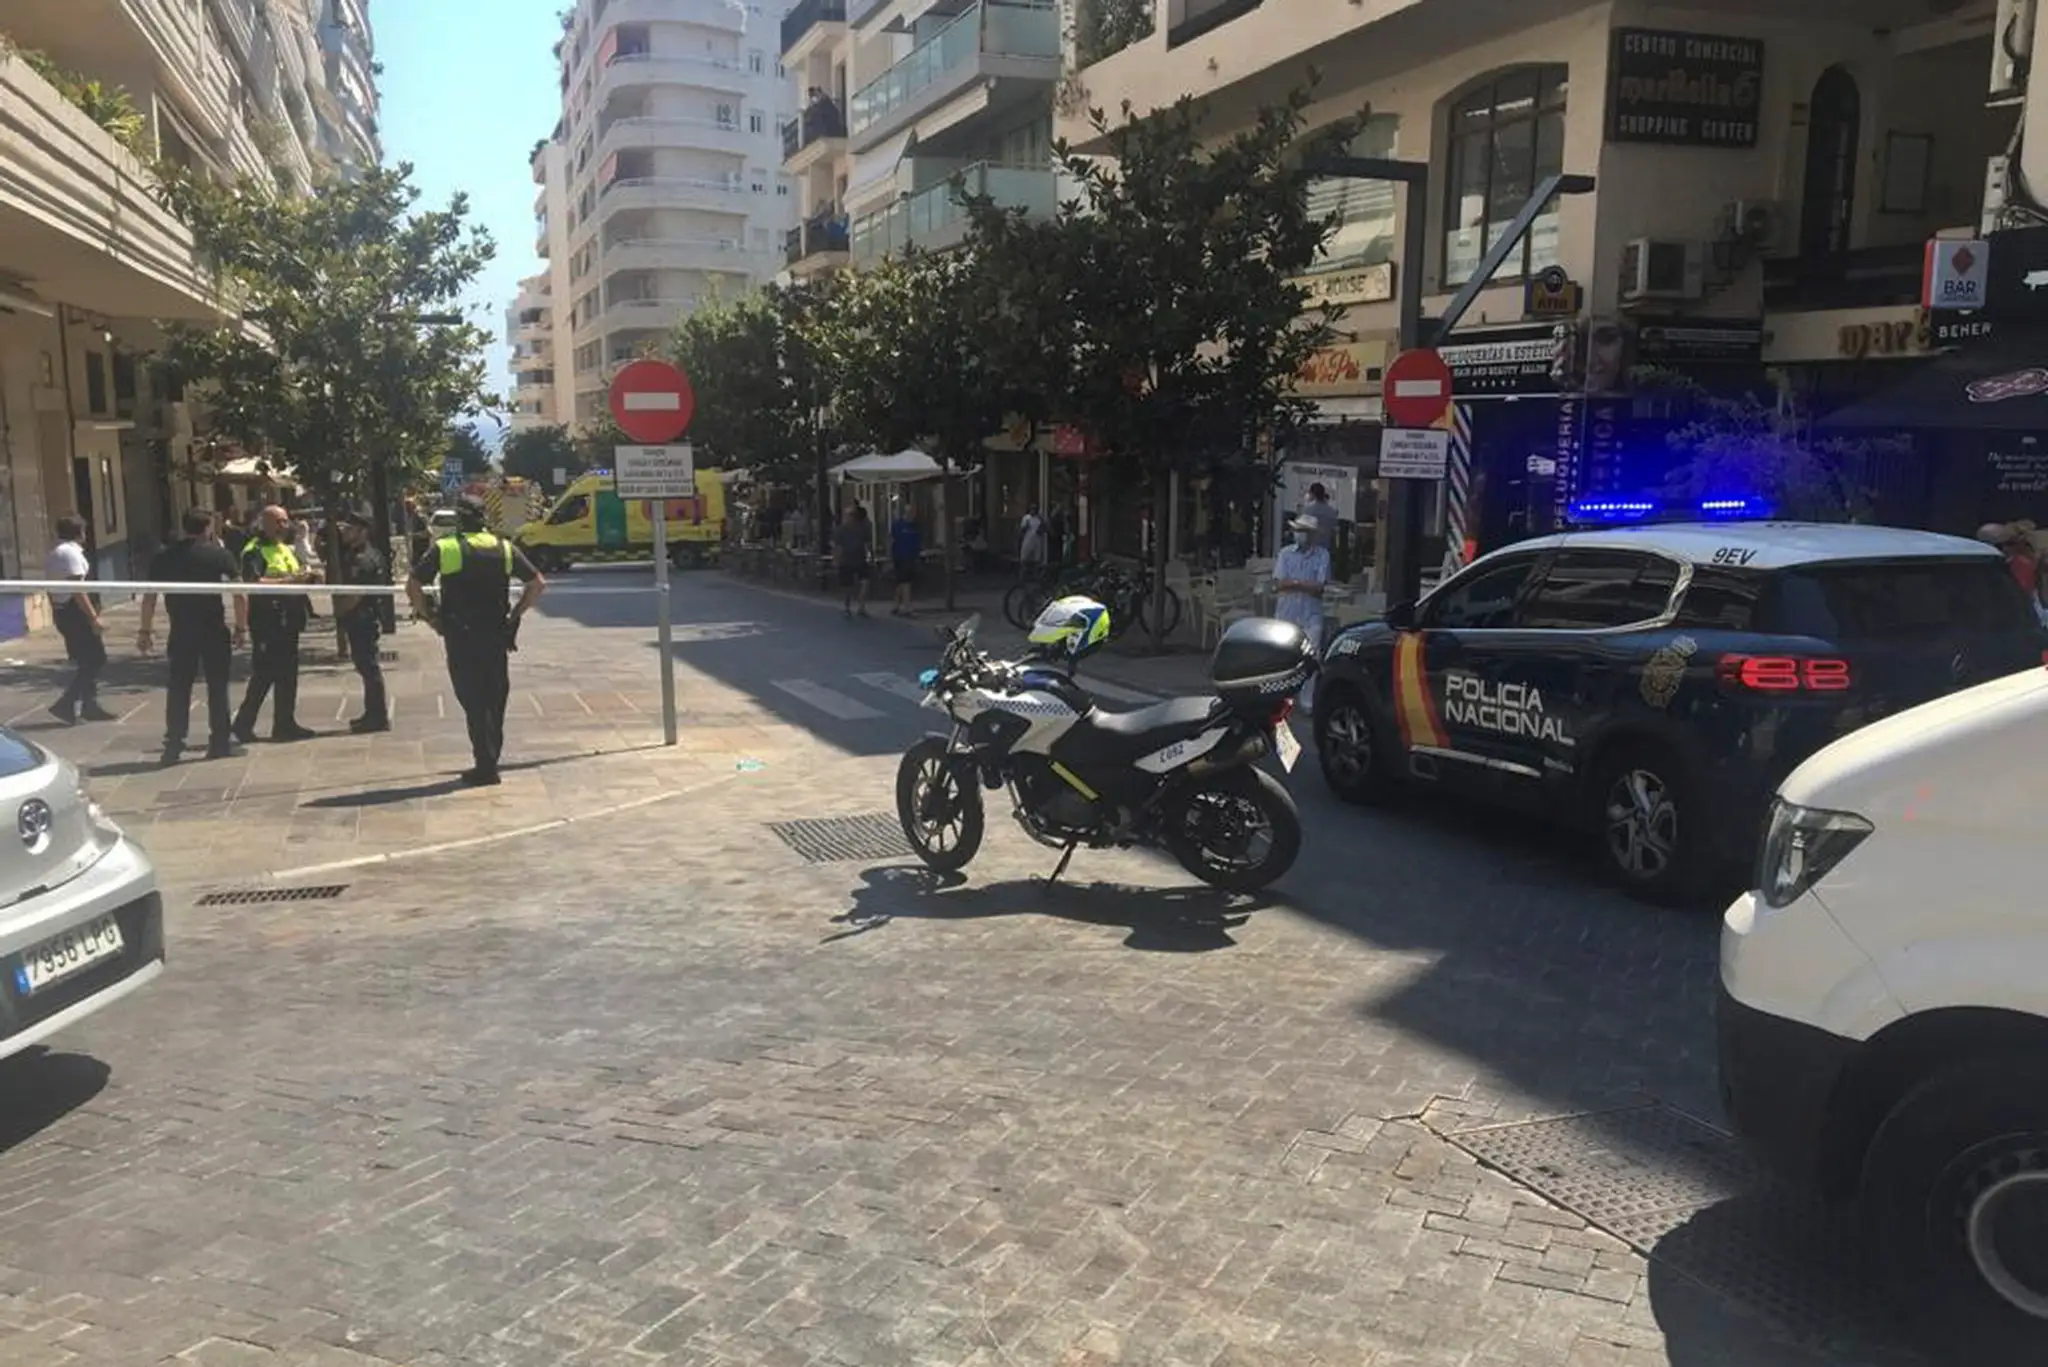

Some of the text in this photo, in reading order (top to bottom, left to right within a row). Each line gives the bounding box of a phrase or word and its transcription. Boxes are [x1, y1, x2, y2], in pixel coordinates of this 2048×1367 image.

[1624, 34, 1756, 64] CENTRO COMERCIAL
[1619, 115, 1753, 141] SHOPPING CENTER
[1944, 279, 1977, 296] BAR
[1712, 547, 1758, 565] 9EV
[1445, 675, 1543, 713] POLICÍA
[1444, 699, 1576, 746] NACIONAL
[25, 936, 78, 982] 7956
